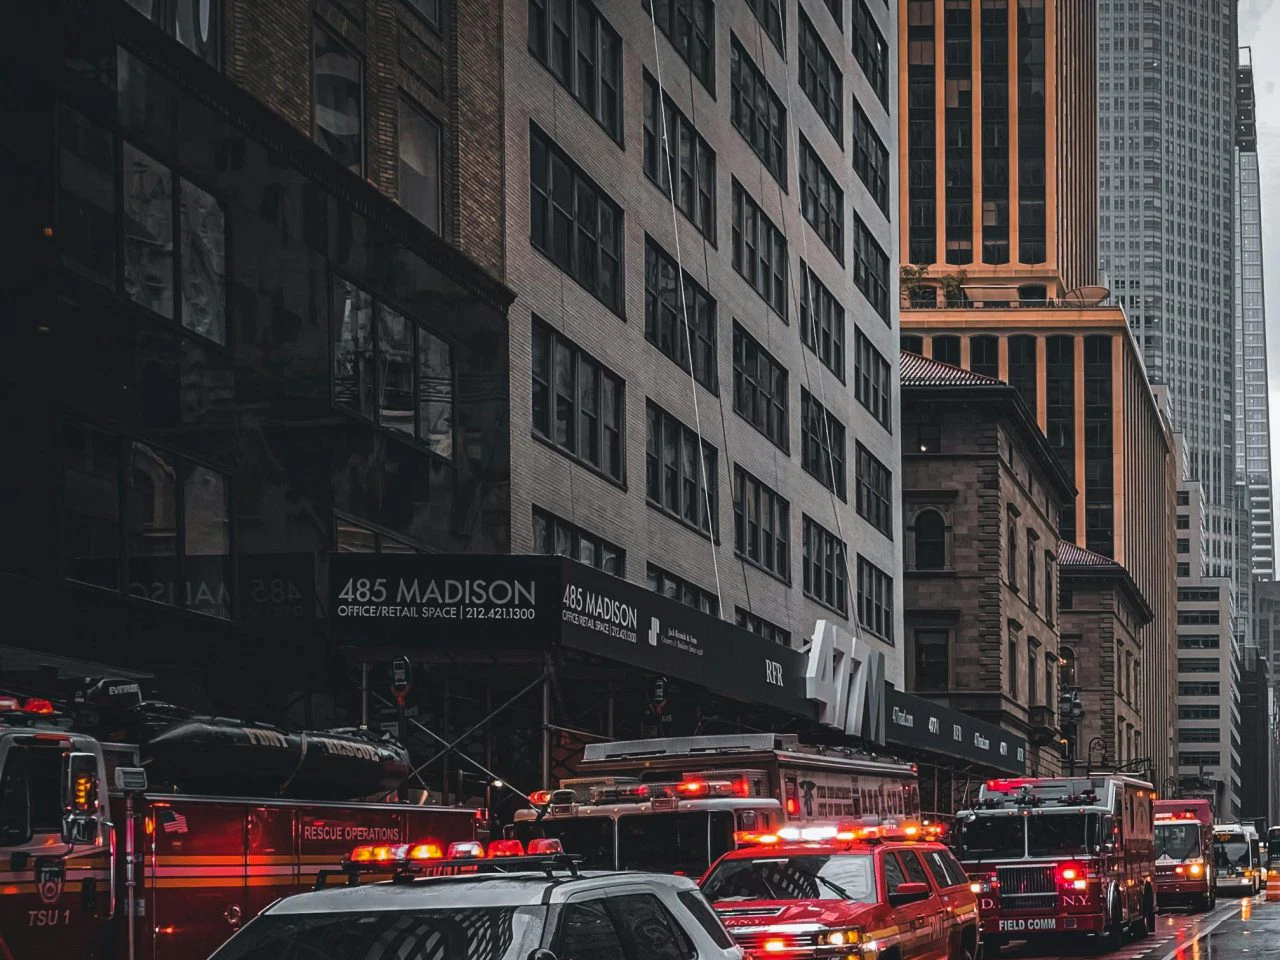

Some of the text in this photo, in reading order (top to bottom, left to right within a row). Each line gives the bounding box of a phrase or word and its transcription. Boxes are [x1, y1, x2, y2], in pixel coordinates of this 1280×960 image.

[338, 578, 536, 606] 485 MADISON
[337, 605, 419, 619] OFFICE/RETAIL
[421, 606, 457, 619] SPACE
[465, 608, 536, 621] 212.421.1300
[563, 583, 638, 631] 485 MADISON
[764, 658, 784, 688] RFR
[305, 826, 400, 841] RESCUE OPERATIONS
[1062, 895, 1092, 907] N.Y.
[27, 910, 71, 927] TSU 1
[999, 918, 1056, 931] FIELD COMM
